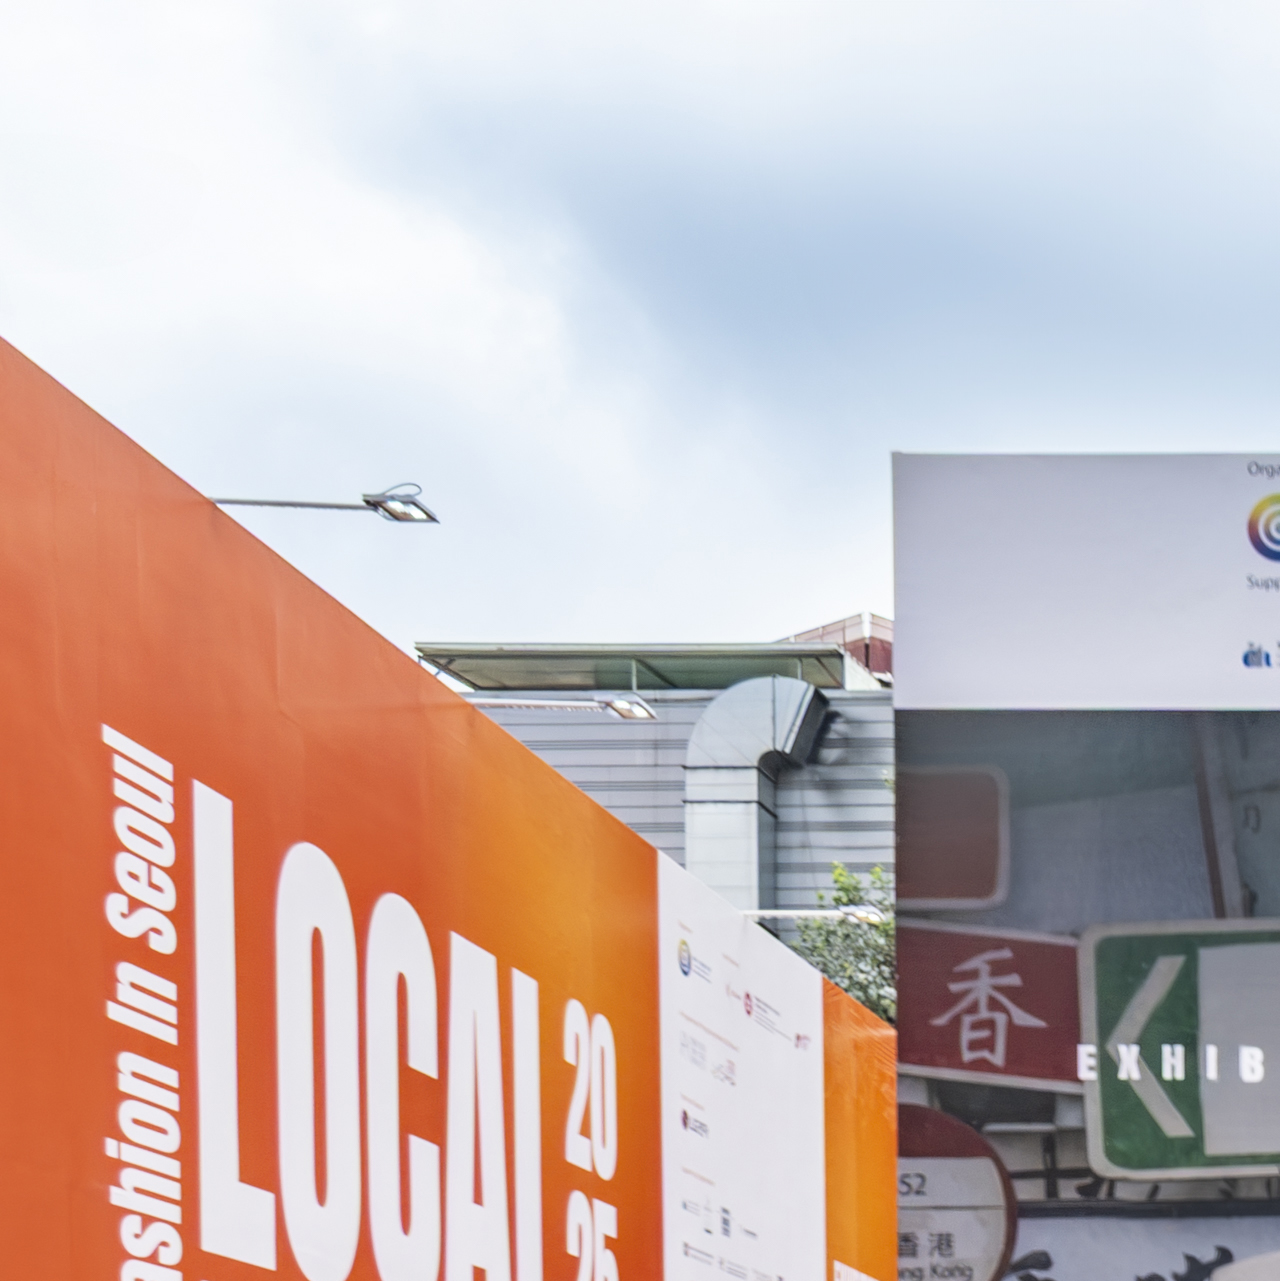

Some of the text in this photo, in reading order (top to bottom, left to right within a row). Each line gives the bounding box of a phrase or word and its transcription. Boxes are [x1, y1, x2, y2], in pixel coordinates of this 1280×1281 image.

[101, 722, 178, 956] Seoul
[105, 960, 179, 1047] In
[929, 947, 1048, 1068] 香
[562, 997, 618, 1182] 20
